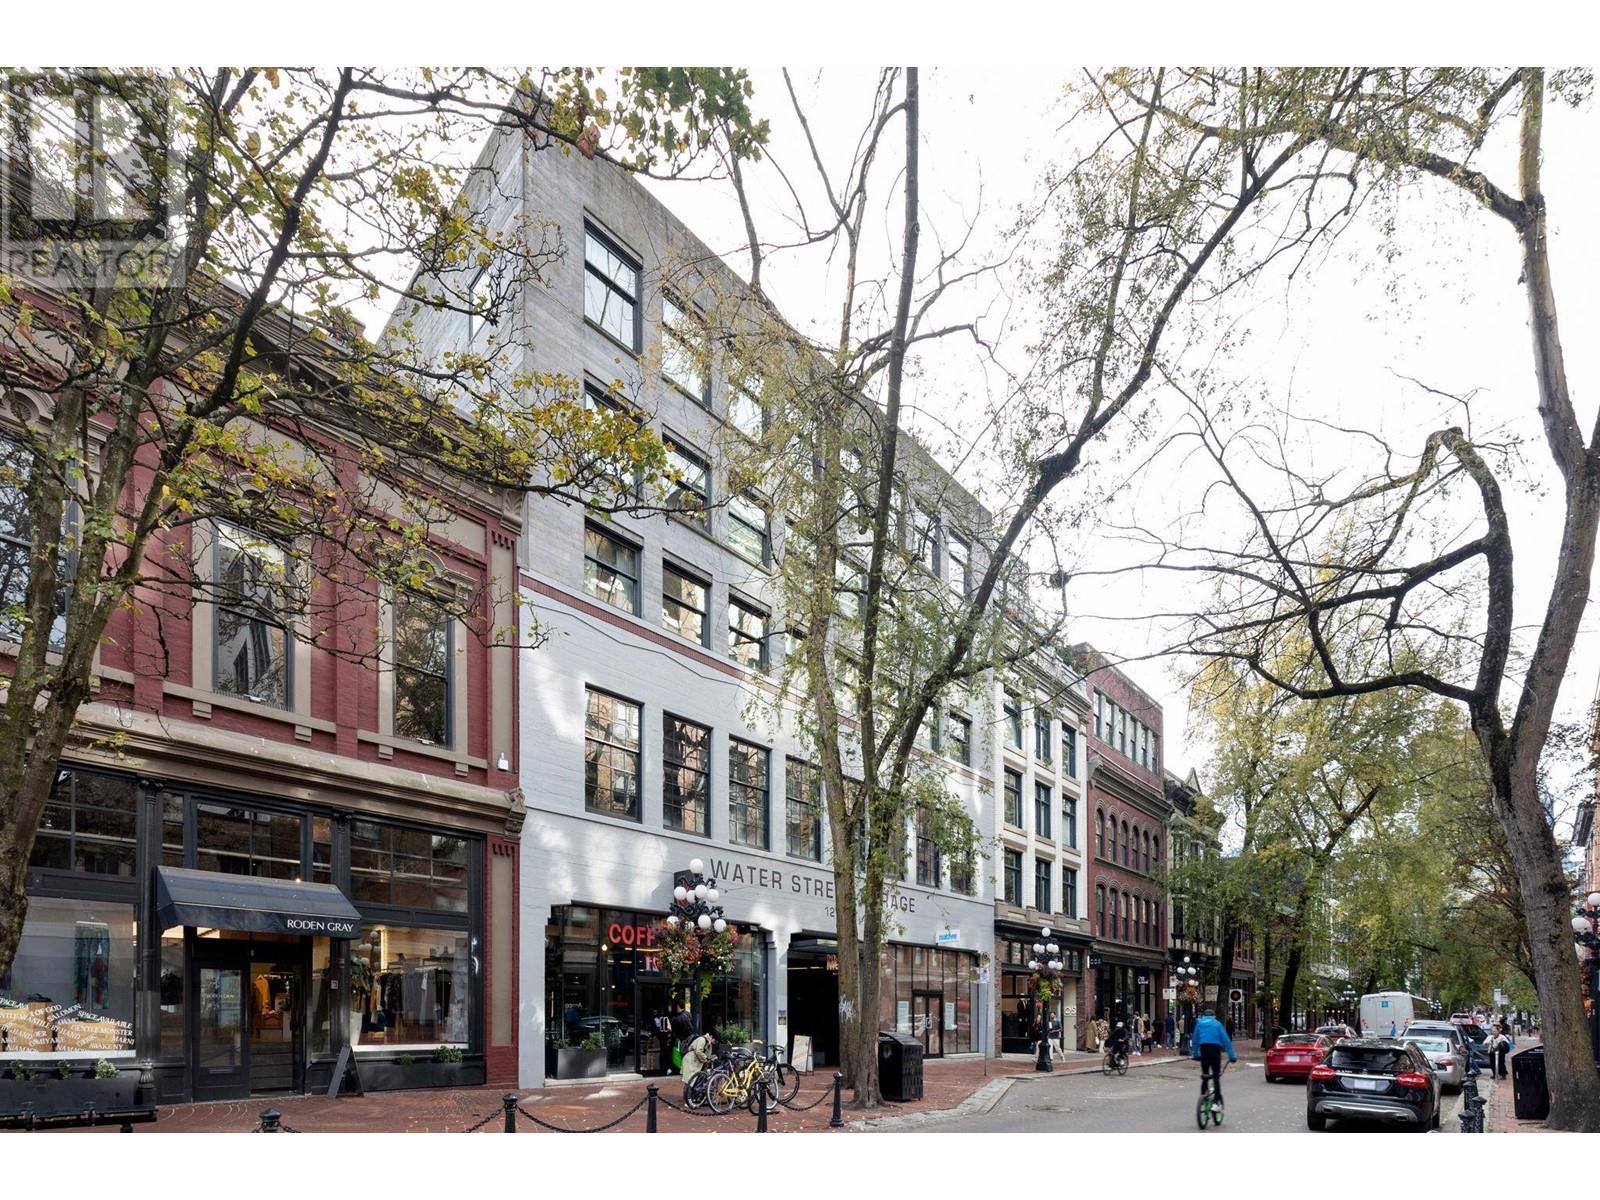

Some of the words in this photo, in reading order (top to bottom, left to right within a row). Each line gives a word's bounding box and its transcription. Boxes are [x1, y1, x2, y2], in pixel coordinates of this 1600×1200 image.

[710, 858, 782, 890] WATER
[791, 874, 834, 899] STRE
[883, 890, 915, 913] RAGE
[287, 919, 325, 931] RODEN
[327, 922, 354, 932] GRAY
[609, 923, 656, 946] COFF
[77, 1010, 99, 1022] SPACE
